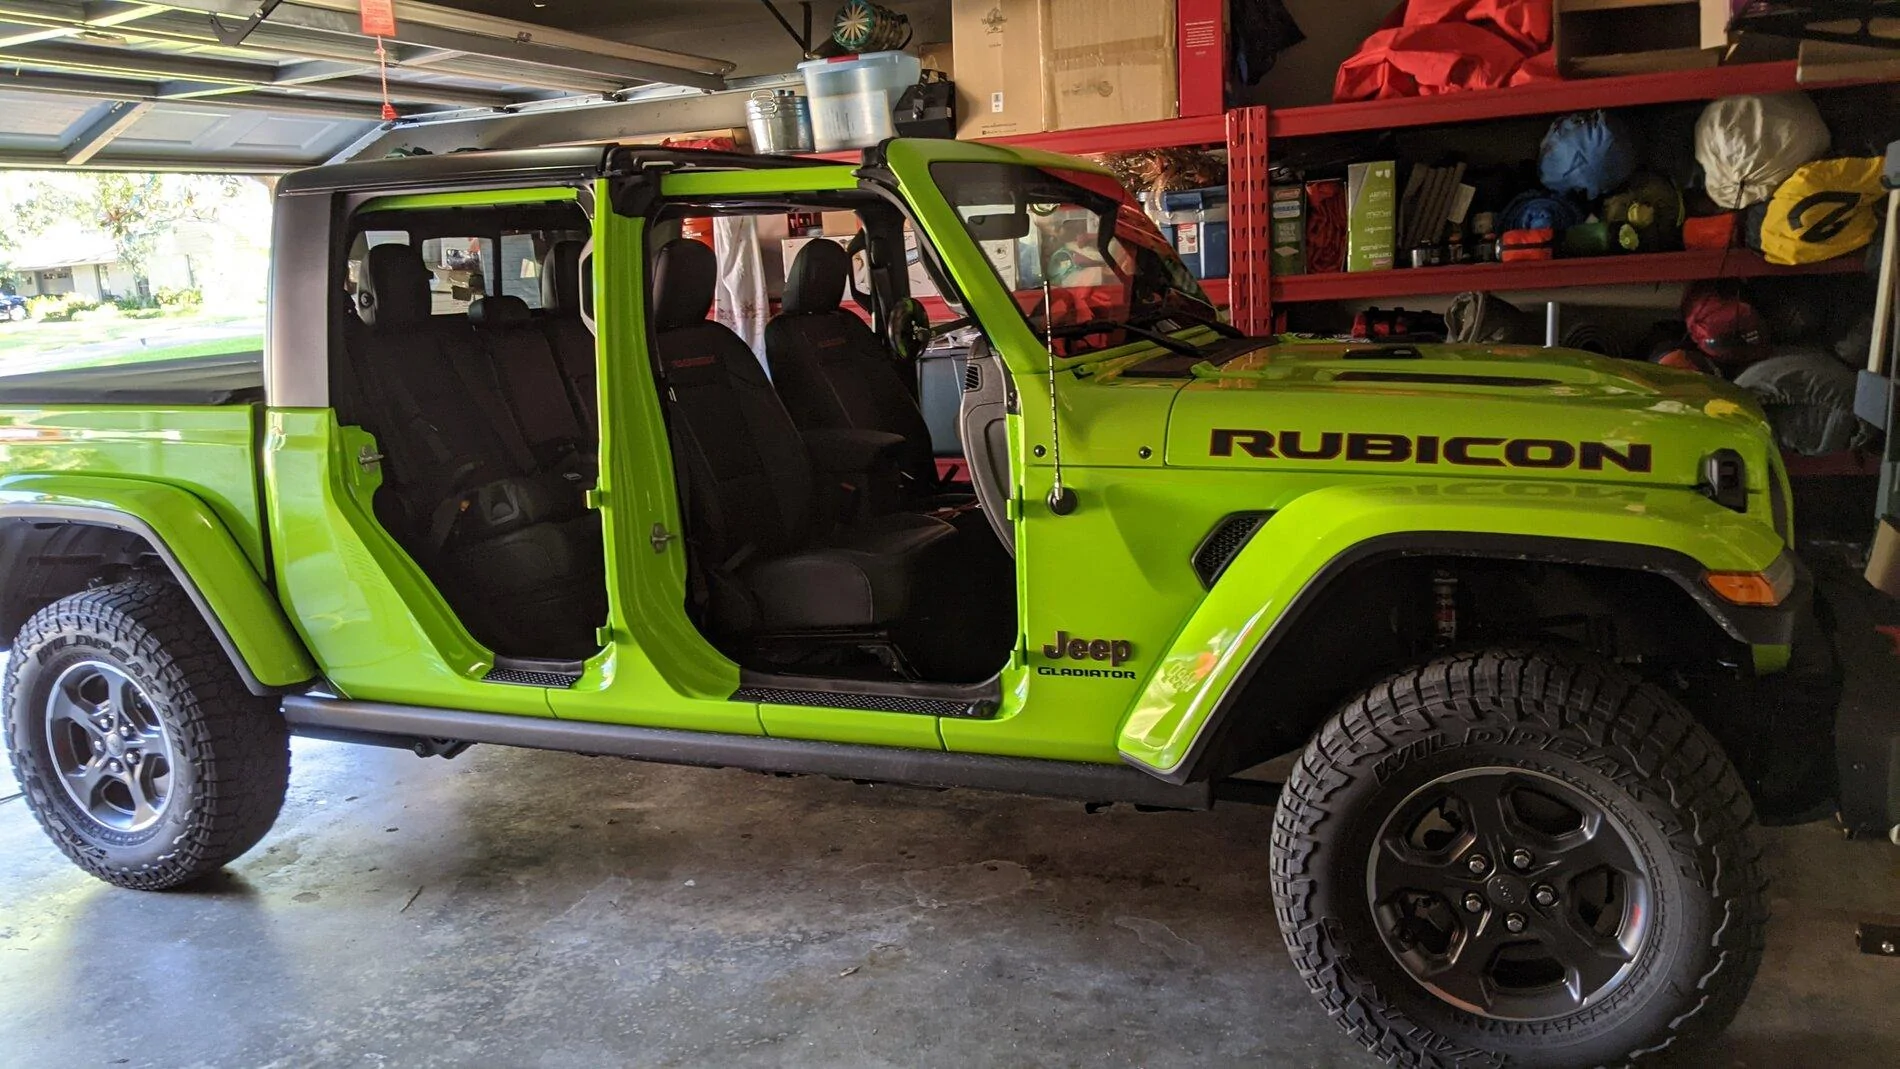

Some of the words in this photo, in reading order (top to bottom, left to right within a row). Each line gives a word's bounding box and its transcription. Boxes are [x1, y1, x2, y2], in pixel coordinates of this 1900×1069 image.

[1209, 428, 1652, 473] RUBICON
[1043, 630, 1133, 667] Jeep
[1037, 666, 1137, 680] GLADIATOR
[1372, 726, 1650, 799] WILDPEAK
